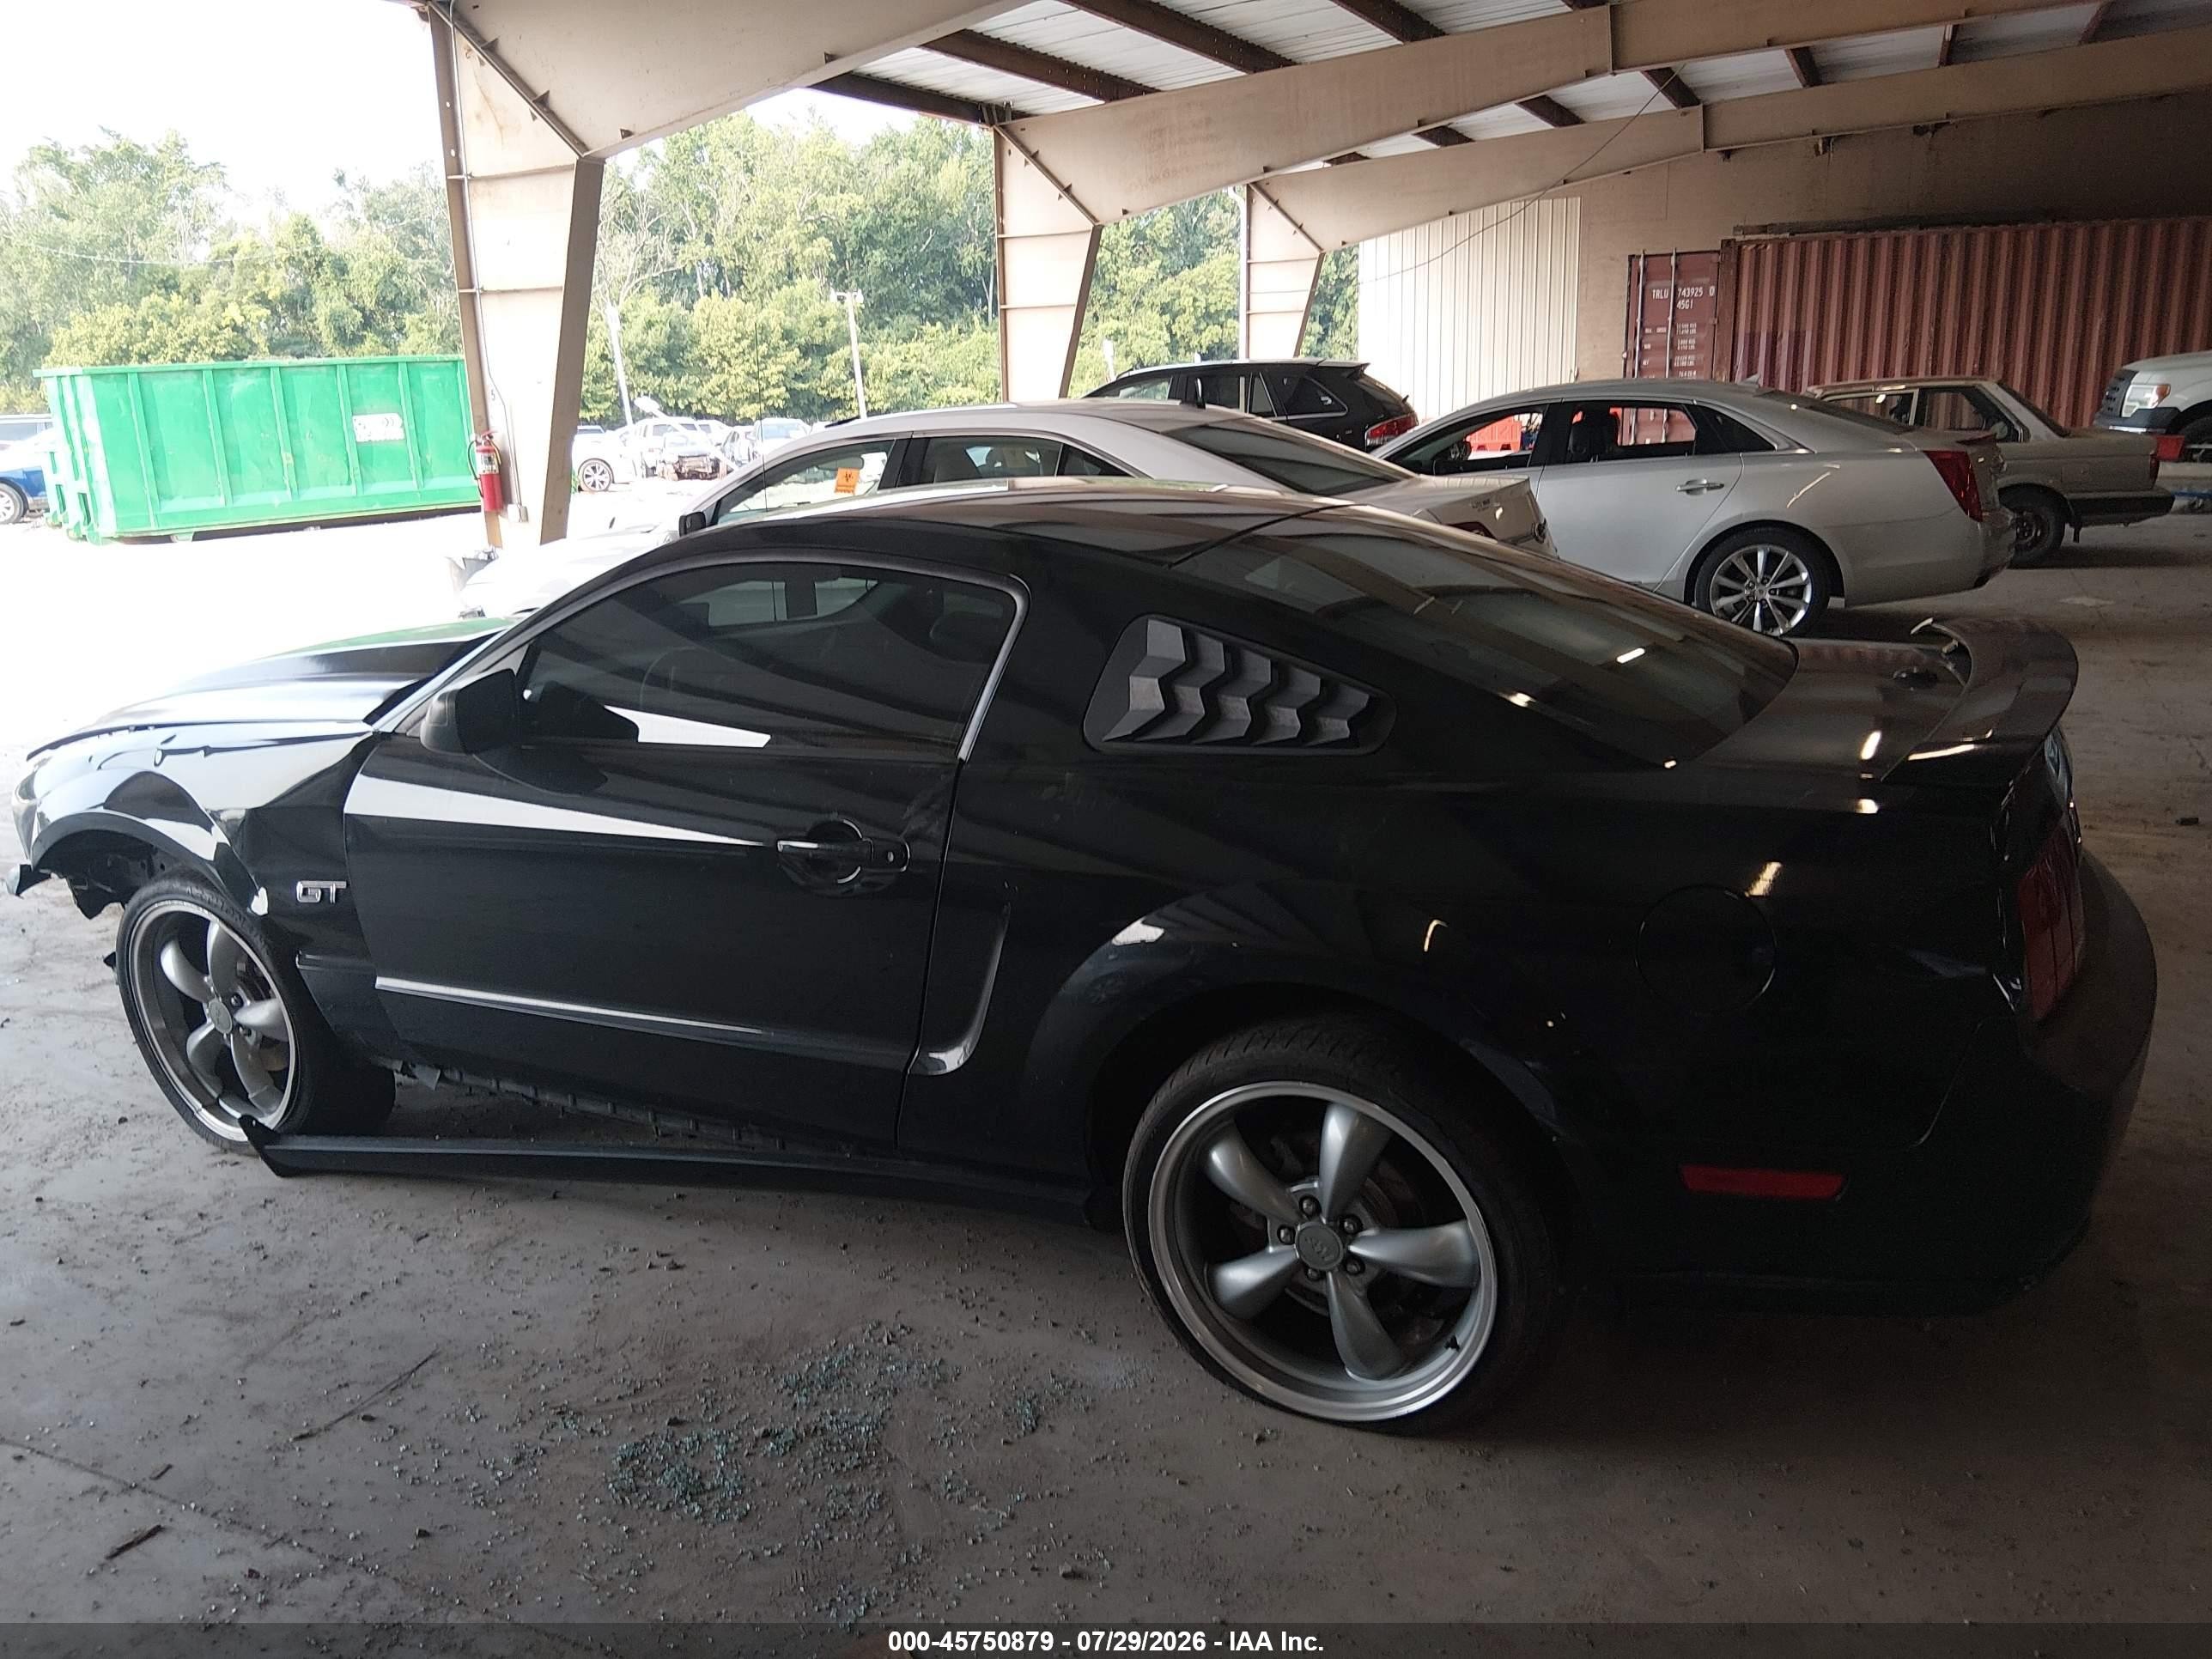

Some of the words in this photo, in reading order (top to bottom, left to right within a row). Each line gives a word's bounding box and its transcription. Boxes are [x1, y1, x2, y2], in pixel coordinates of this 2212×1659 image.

[1652, 288, 1668, 299] TRLU
[1677, 286, 1704, 297] 743925
[1676, 299, 1693, 309] 45G1
[296, 880, 347, 903] GT
